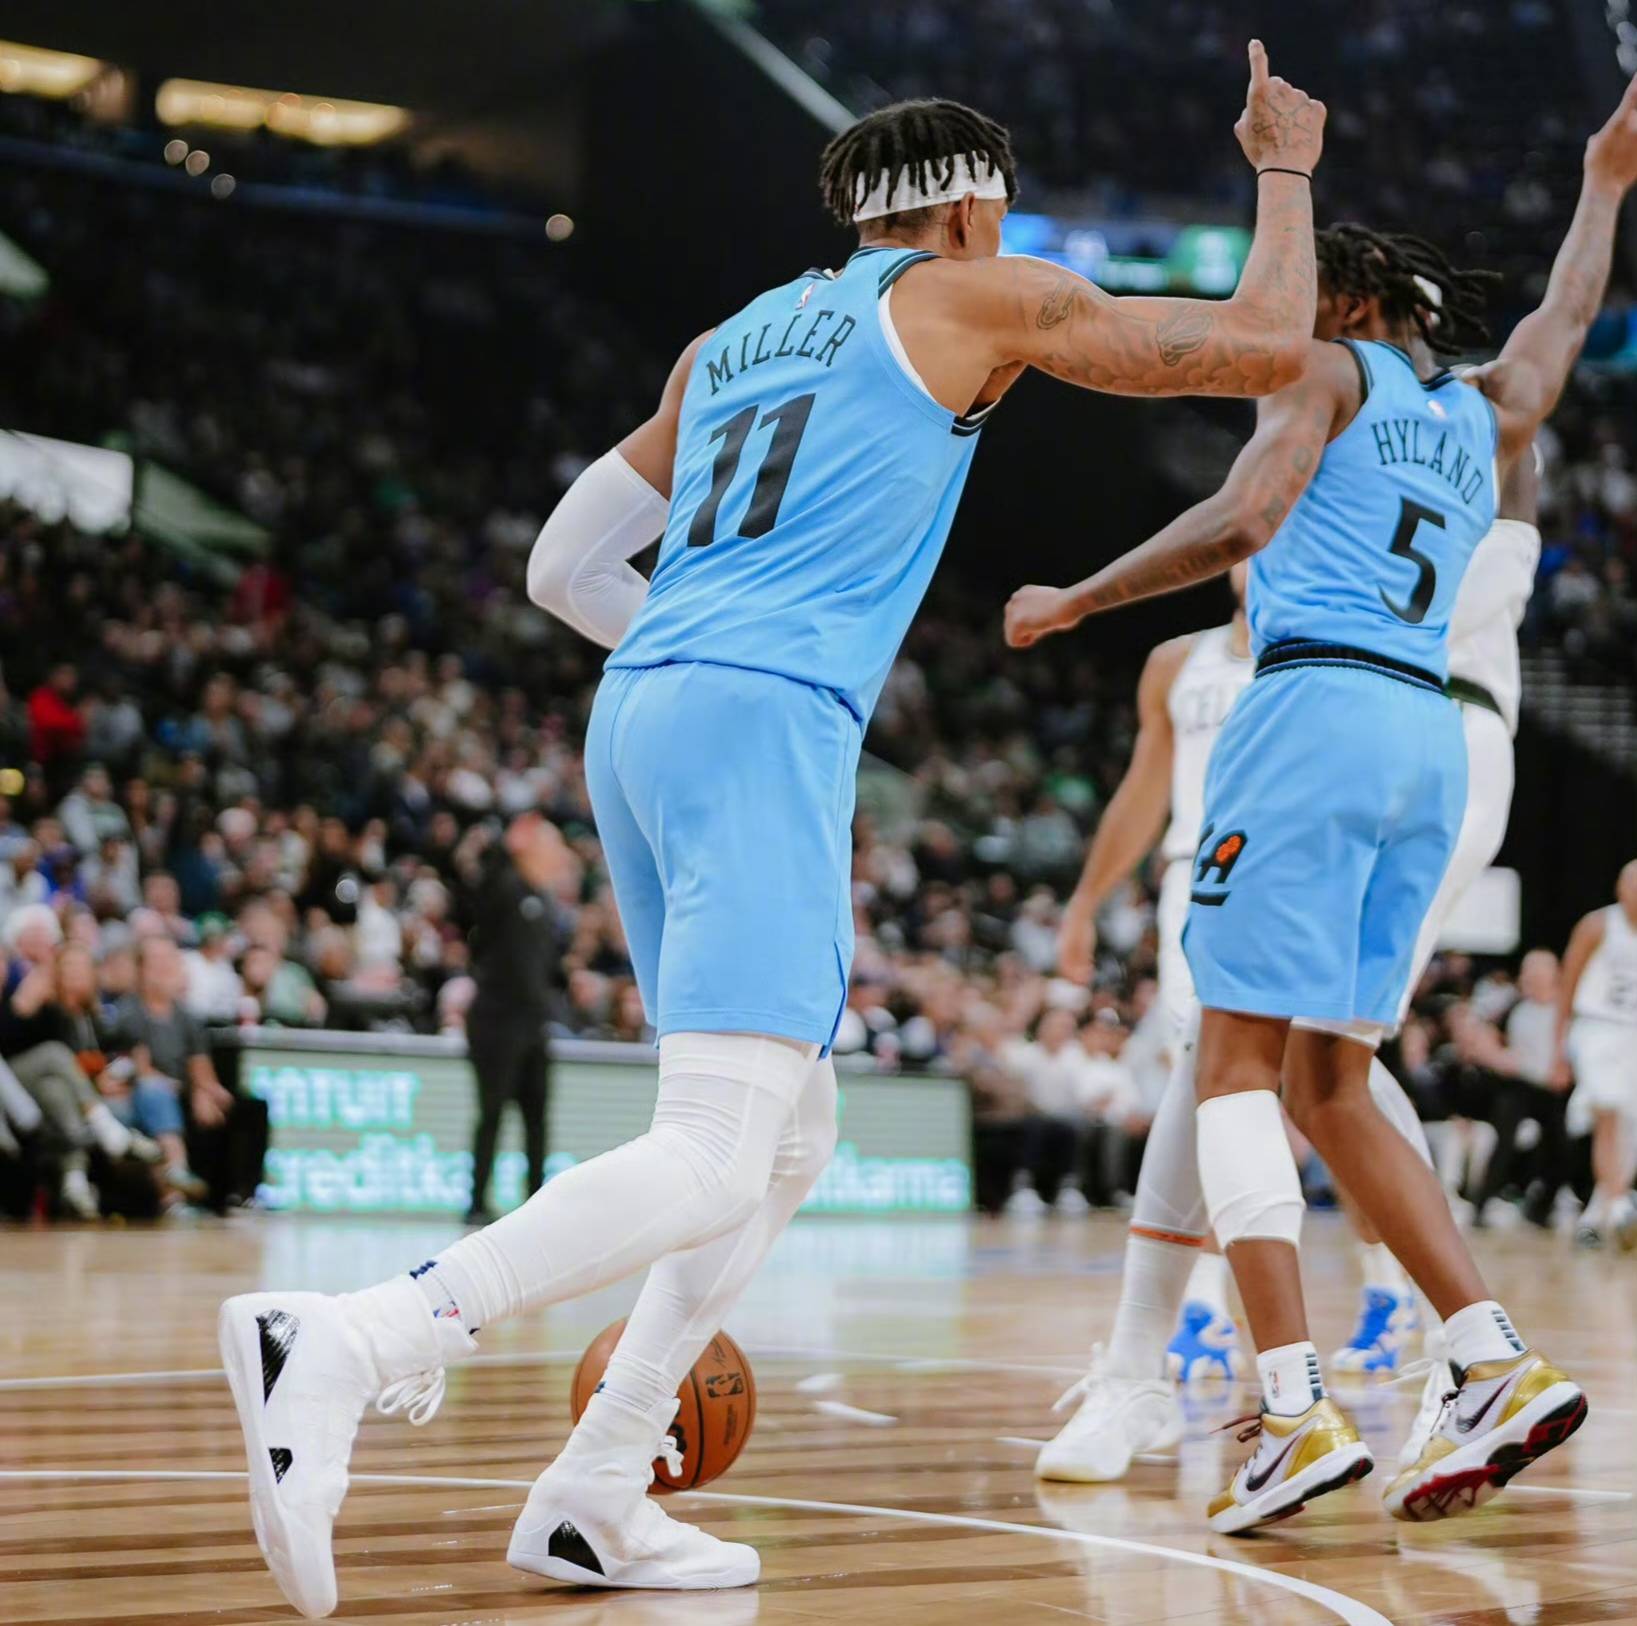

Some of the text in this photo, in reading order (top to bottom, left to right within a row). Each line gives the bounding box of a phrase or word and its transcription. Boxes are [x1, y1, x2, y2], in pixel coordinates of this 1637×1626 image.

[706, 310, 856, 396] MILLER
[686, 393, 817, 548] 11
[1371, 419, 1484, 505] HYLAND
[1377, 496, 1447, 625] 5
